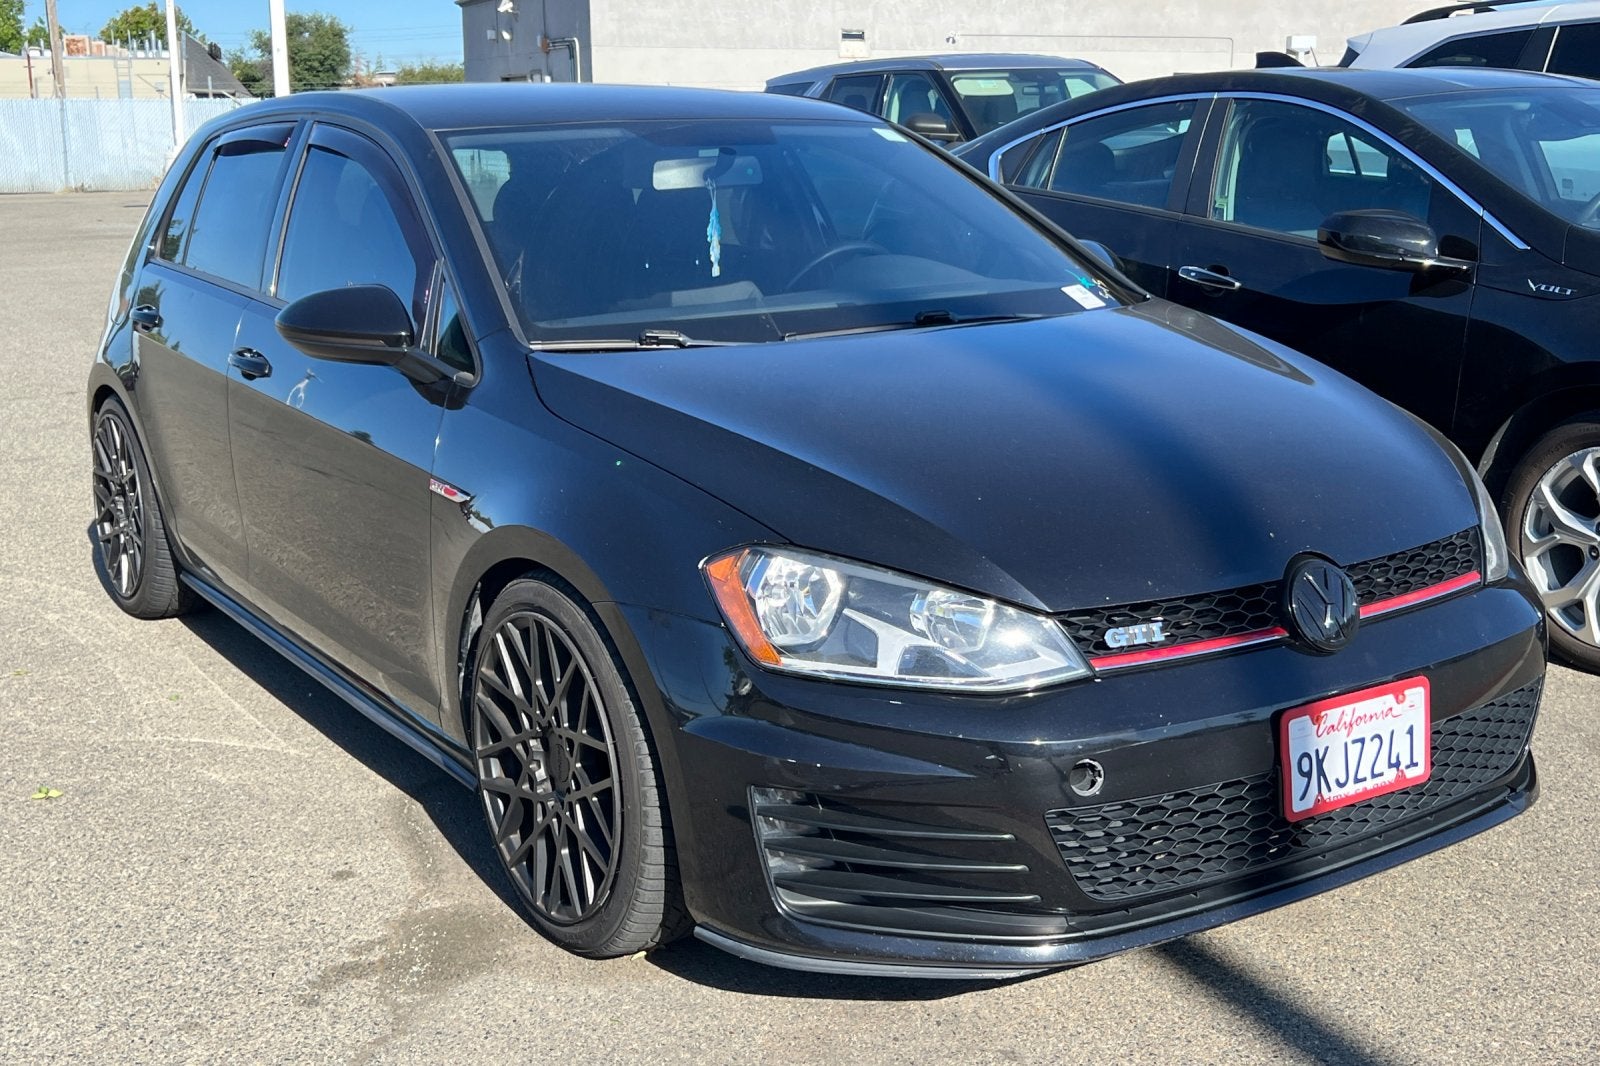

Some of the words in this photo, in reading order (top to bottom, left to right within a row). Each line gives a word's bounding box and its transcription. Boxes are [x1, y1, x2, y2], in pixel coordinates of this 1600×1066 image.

[1527, 278, 1578, 295] VOLT
[1104, 621, 1166, 648] GTI
[1315, 703, 1402, 738] California
[1296, 724, 1419, 802] 9KJZ241
